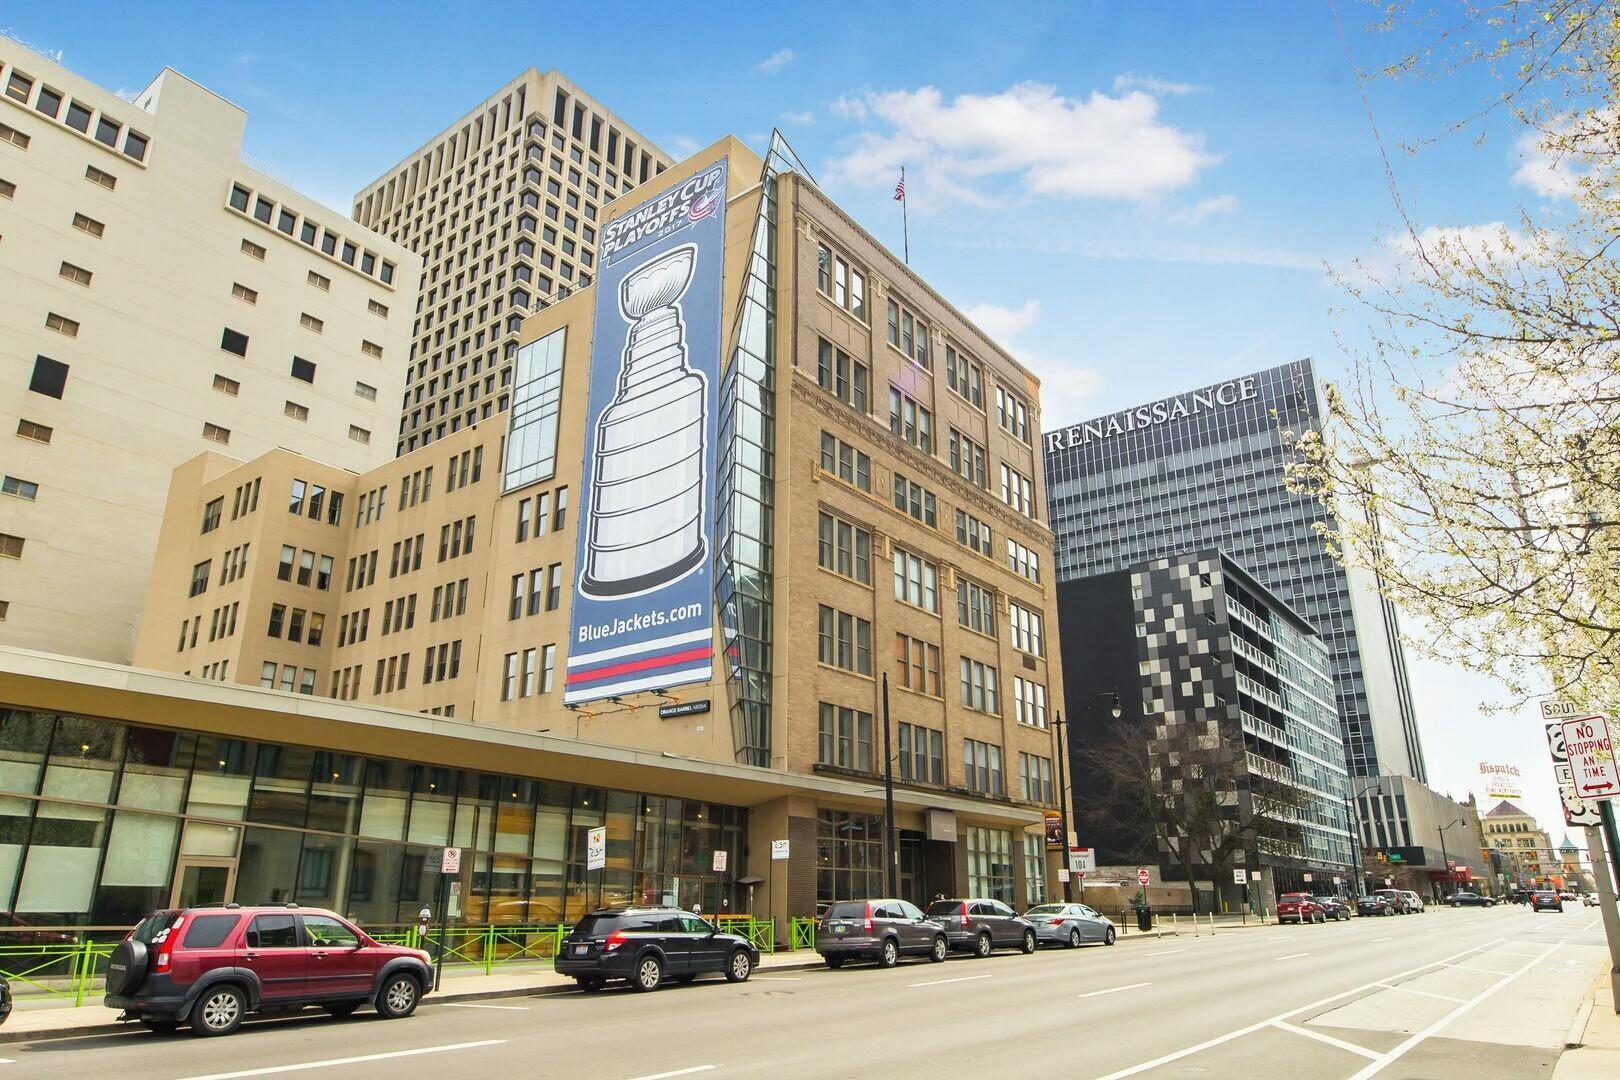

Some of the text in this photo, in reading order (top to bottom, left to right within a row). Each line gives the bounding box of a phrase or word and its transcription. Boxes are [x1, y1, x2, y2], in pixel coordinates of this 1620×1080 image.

[604, 169, 720, 243] STANLEY CUP
[603, 200, 691, 258] PLAYOFFS
[657, 219, 683, 238] 2017
[1047, 376, 1258, 454] RENAISSANCE
[578, 602, 702, 643] BlueJackets.com
[693, 703, 707, 711] MEDIA
[1544, 702, 1576, 716] SOUT
[1575, 725, 1594, 740] NO
[1567, 738, 1611, 756] STOPPING
[1583, 755, 1598, 767] AN
[1478, 762, 1521, 777] Dispatch
[1584, 767, 1606, 779] TIME
